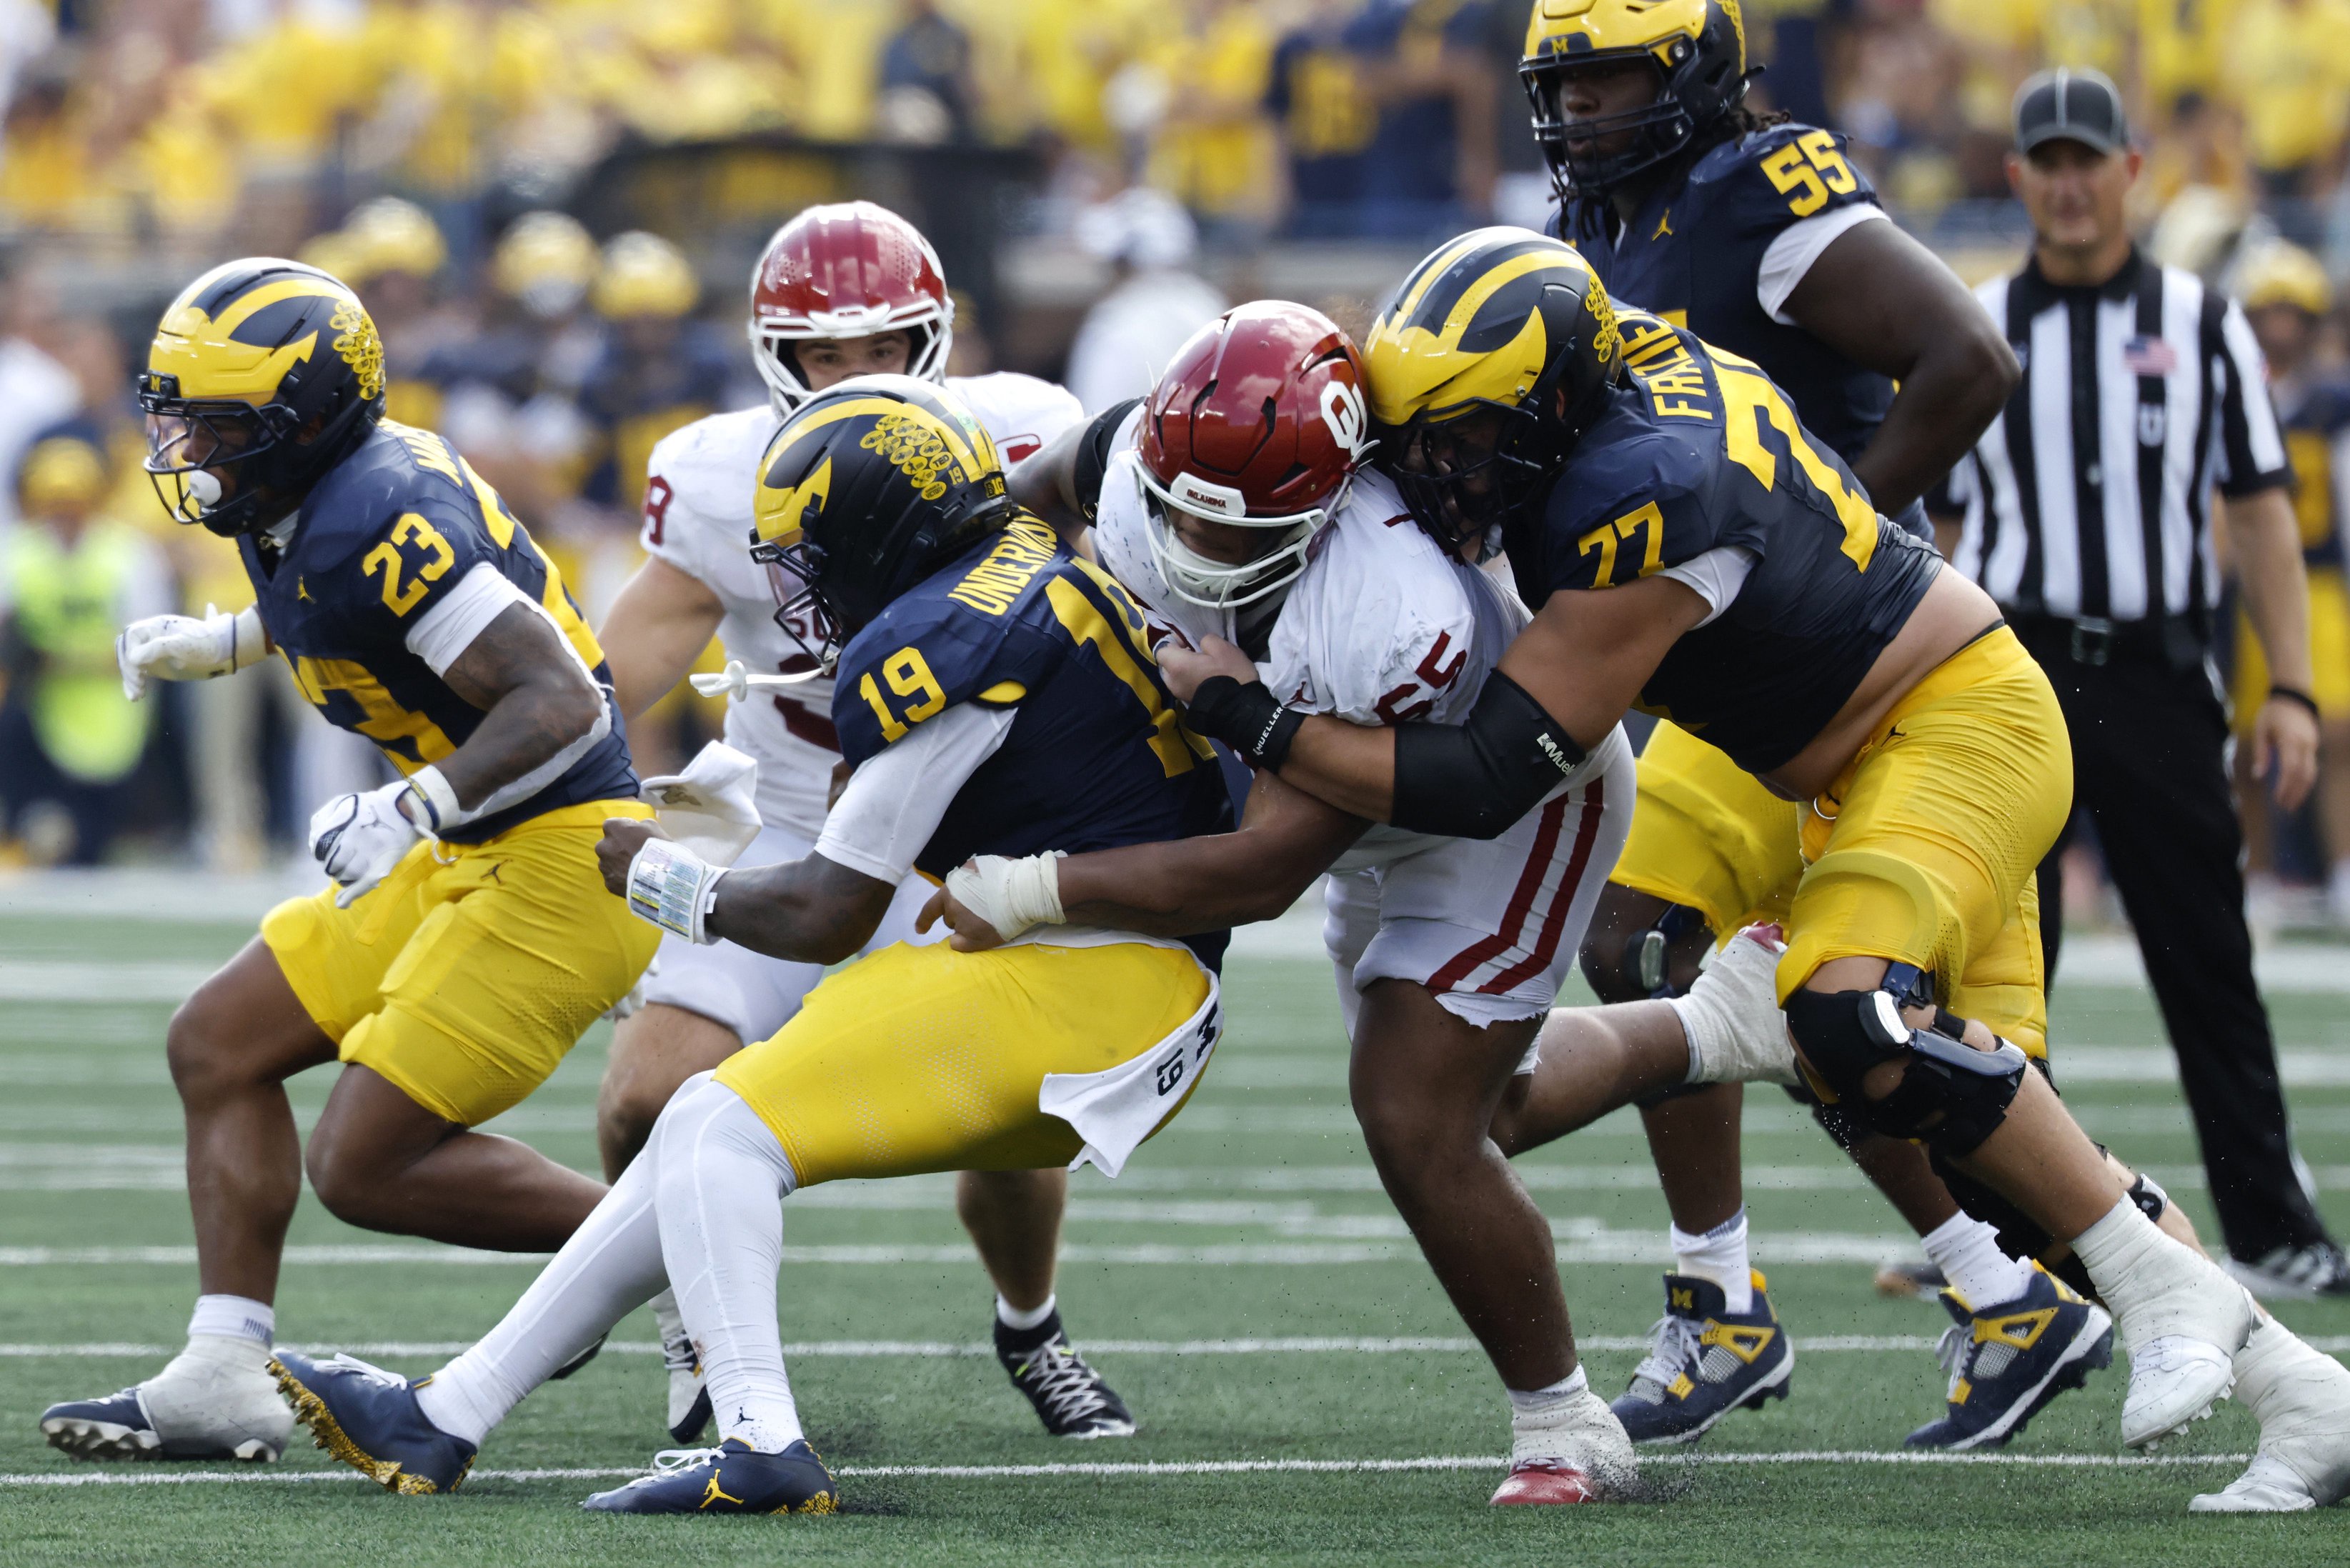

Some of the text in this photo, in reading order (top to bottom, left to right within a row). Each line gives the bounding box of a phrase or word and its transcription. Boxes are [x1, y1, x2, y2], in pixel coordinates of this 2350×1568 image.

[1551, 38, 1568, 54] M
[1760, 129, 1857, 217] 55
[932, 456, 950, 468] TED
[947, 466, 964, 486] 19
[362, 513, 455, 618] 23
[1578, 501, 1664, 590] 77
[860, 646, 947, 744] 19
[1255, 706, 1284, 752] MUELLER
[1157, 1048, 1183, 1097] 19
